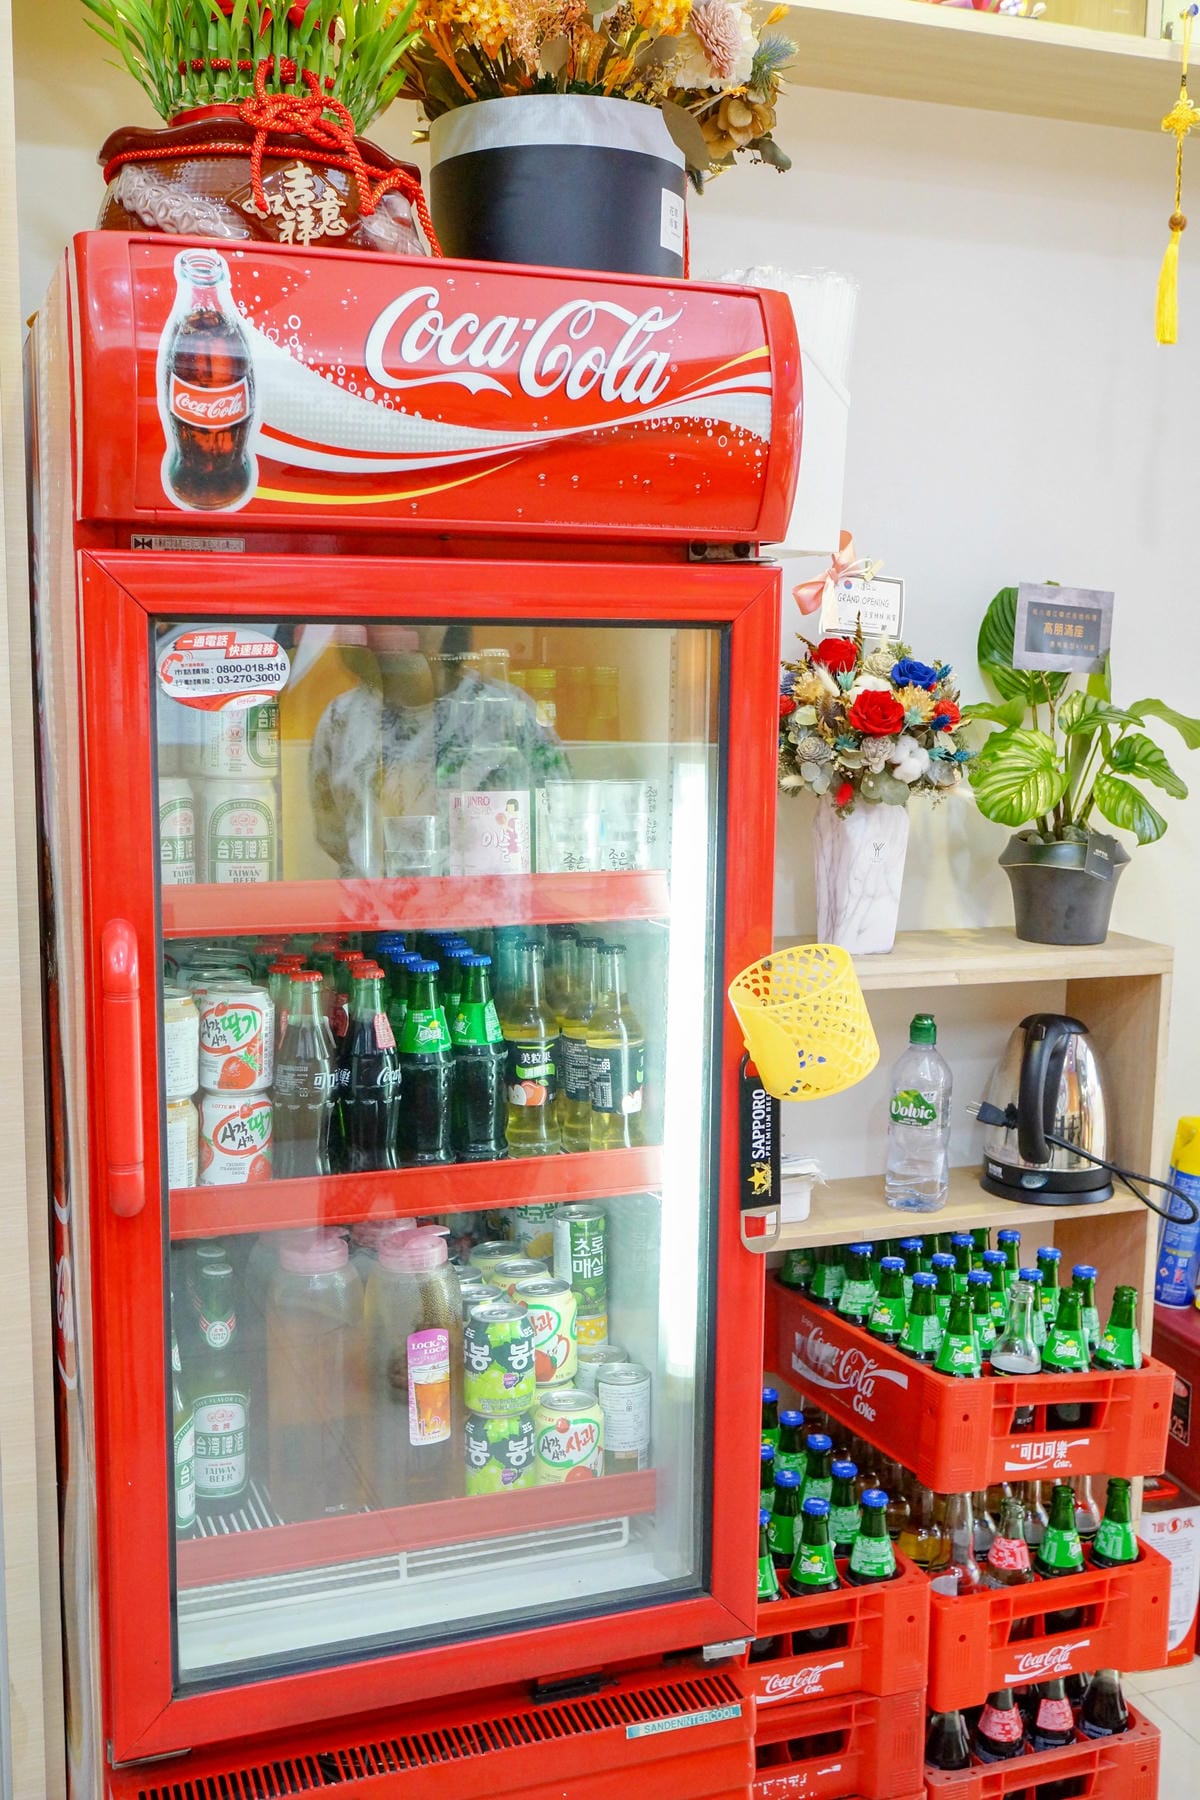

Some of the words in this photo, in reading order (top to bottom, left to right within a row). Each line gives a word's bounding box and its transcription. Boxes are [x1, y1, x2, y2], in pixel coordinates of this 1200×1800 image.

[365, 286, 684, 405] Coca-Cola
[175, 392, 244, 419] Coca-Cola
[837, 592, 860, 604] GRAND
[862, 596, 889, 608] OPENING
[182, 634, 229, 648] 一通電話
[228, 644, 275, 657] 快速服務
[216, 662, 287, 674] 0800-018-818
[217, 673, 281, 685] 03-270-3000
[228, 869, 260, 878] TAIWAN
[519, 1050, 553, 1065] 美粒果
[891, 1100, 934, 1120] Volvic
[752, 1089, 766, 1159] SAPPORO
[572, 1235, 604, 1257] 초록
[572, 1259, 604, 1279] 매실
[1020, 1440, 1069, 1461] 可口可樂
[204, 1465, 236, 1476] TAIWAN
[208, 1474, 233, 1483] BEER
[765, 1665, 824, 1694] Coca-Cola
